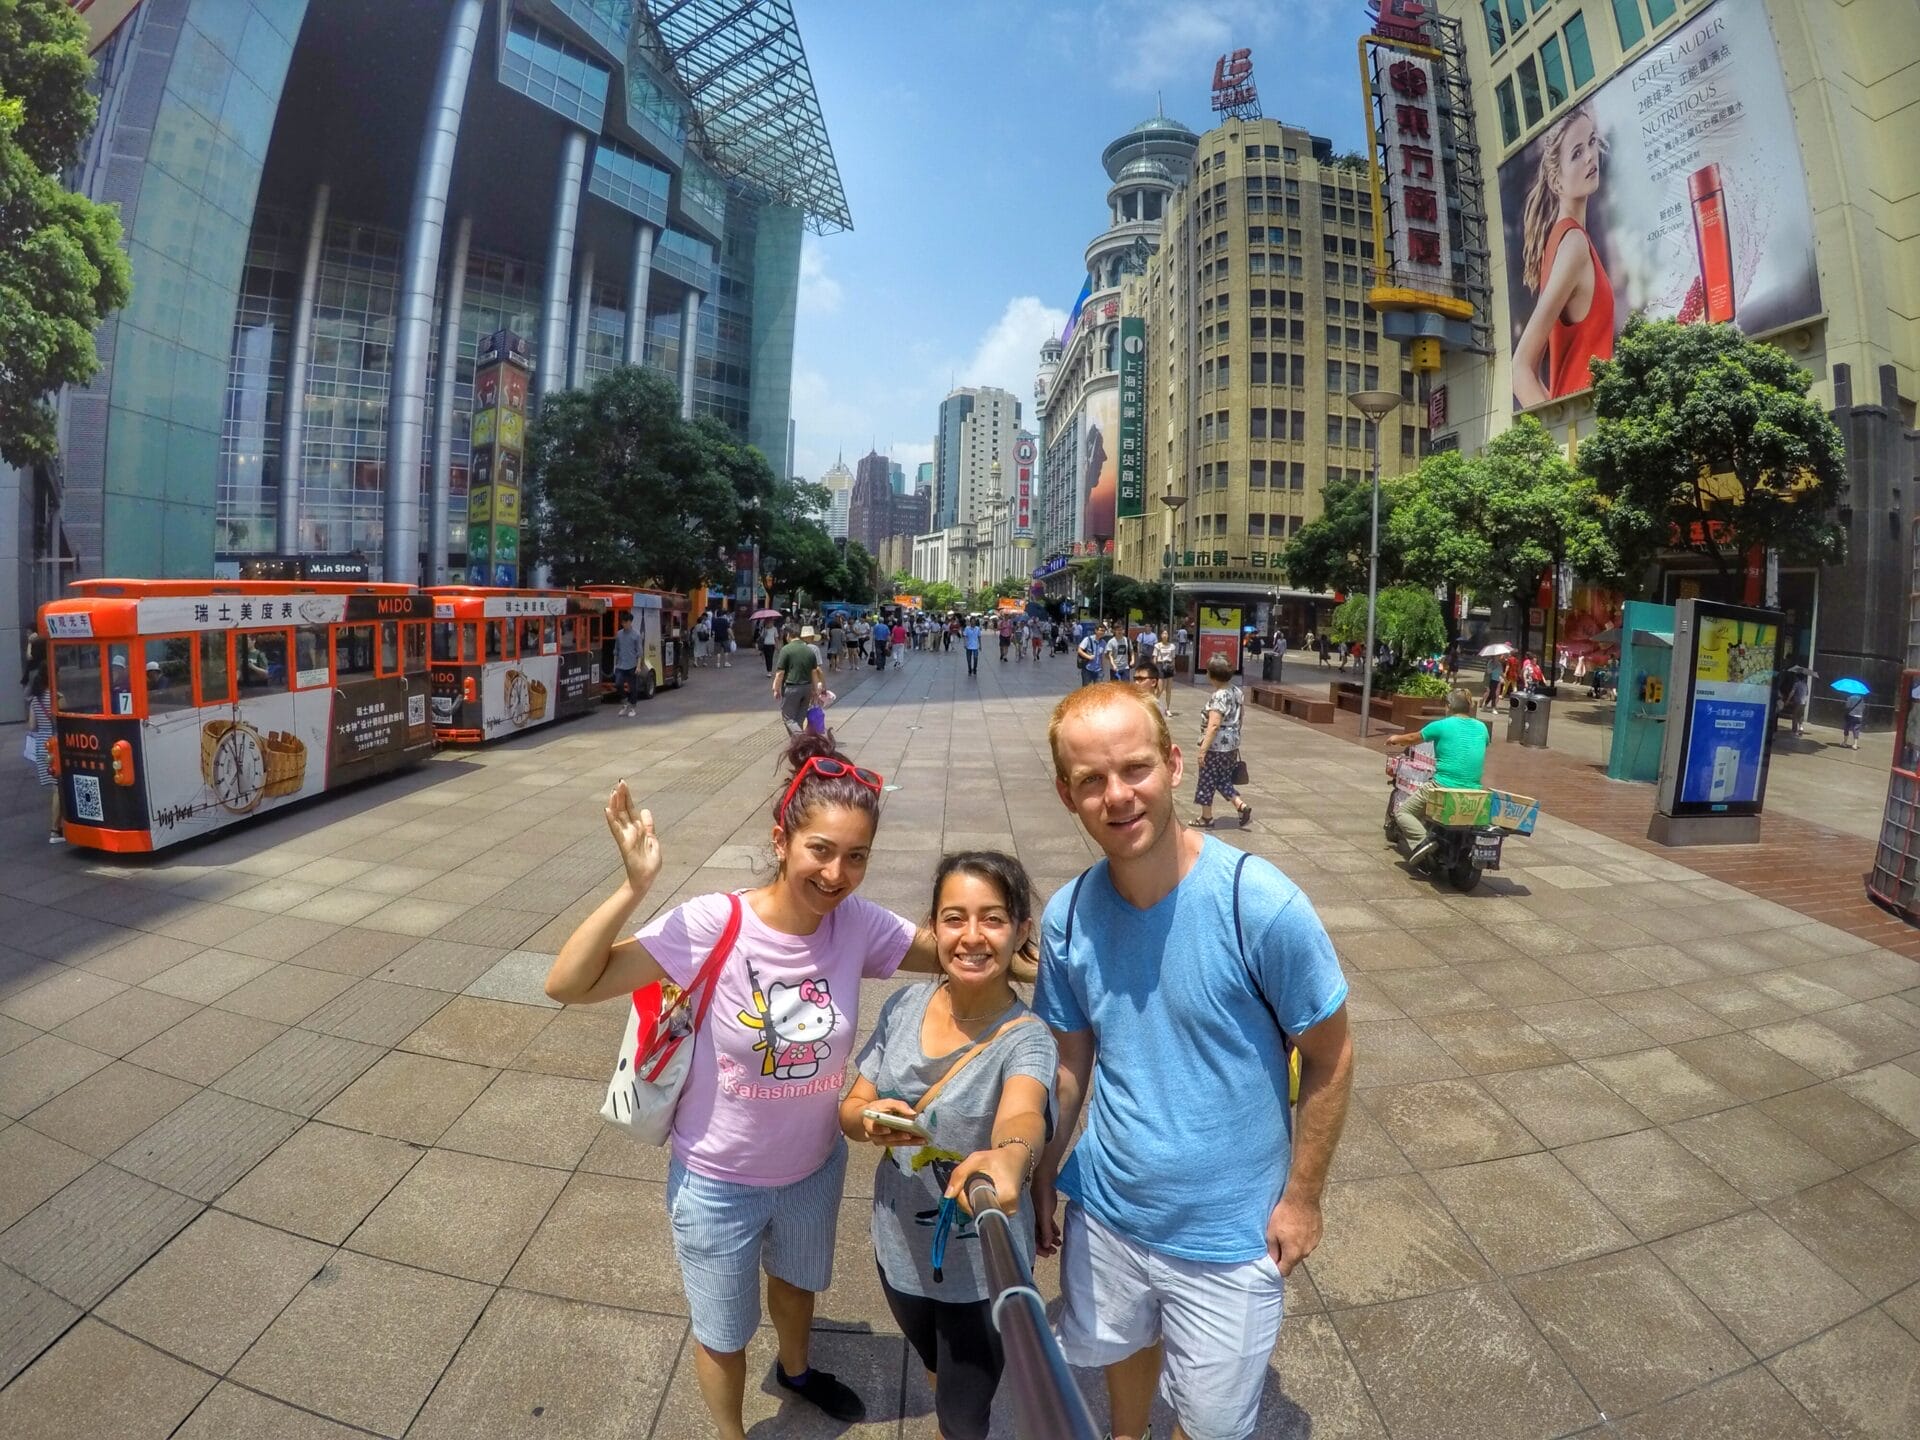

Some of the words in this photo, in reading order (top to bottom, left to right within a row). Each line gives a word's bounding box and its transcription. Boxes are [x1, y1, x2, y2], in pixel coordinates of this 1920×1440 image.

[1669, 17, 1725, 65] LAUDER
[1642, 81, 1717, 138] NUTRITIOUS
[1122, 360, 1137, 499] 上海市第一百货商店
[335, 564, 361, 573] Store
[1194, 571, 1213, 579] NO.1
[195, 602, 293, 623] 瑞士美度表
[377, 598, 412, 614] MIDO
[121, 695, 131, 712] 7
[65, 733, 99, 750] MIDO
[721, 1071, 845, 1100] Kalashnikitt
